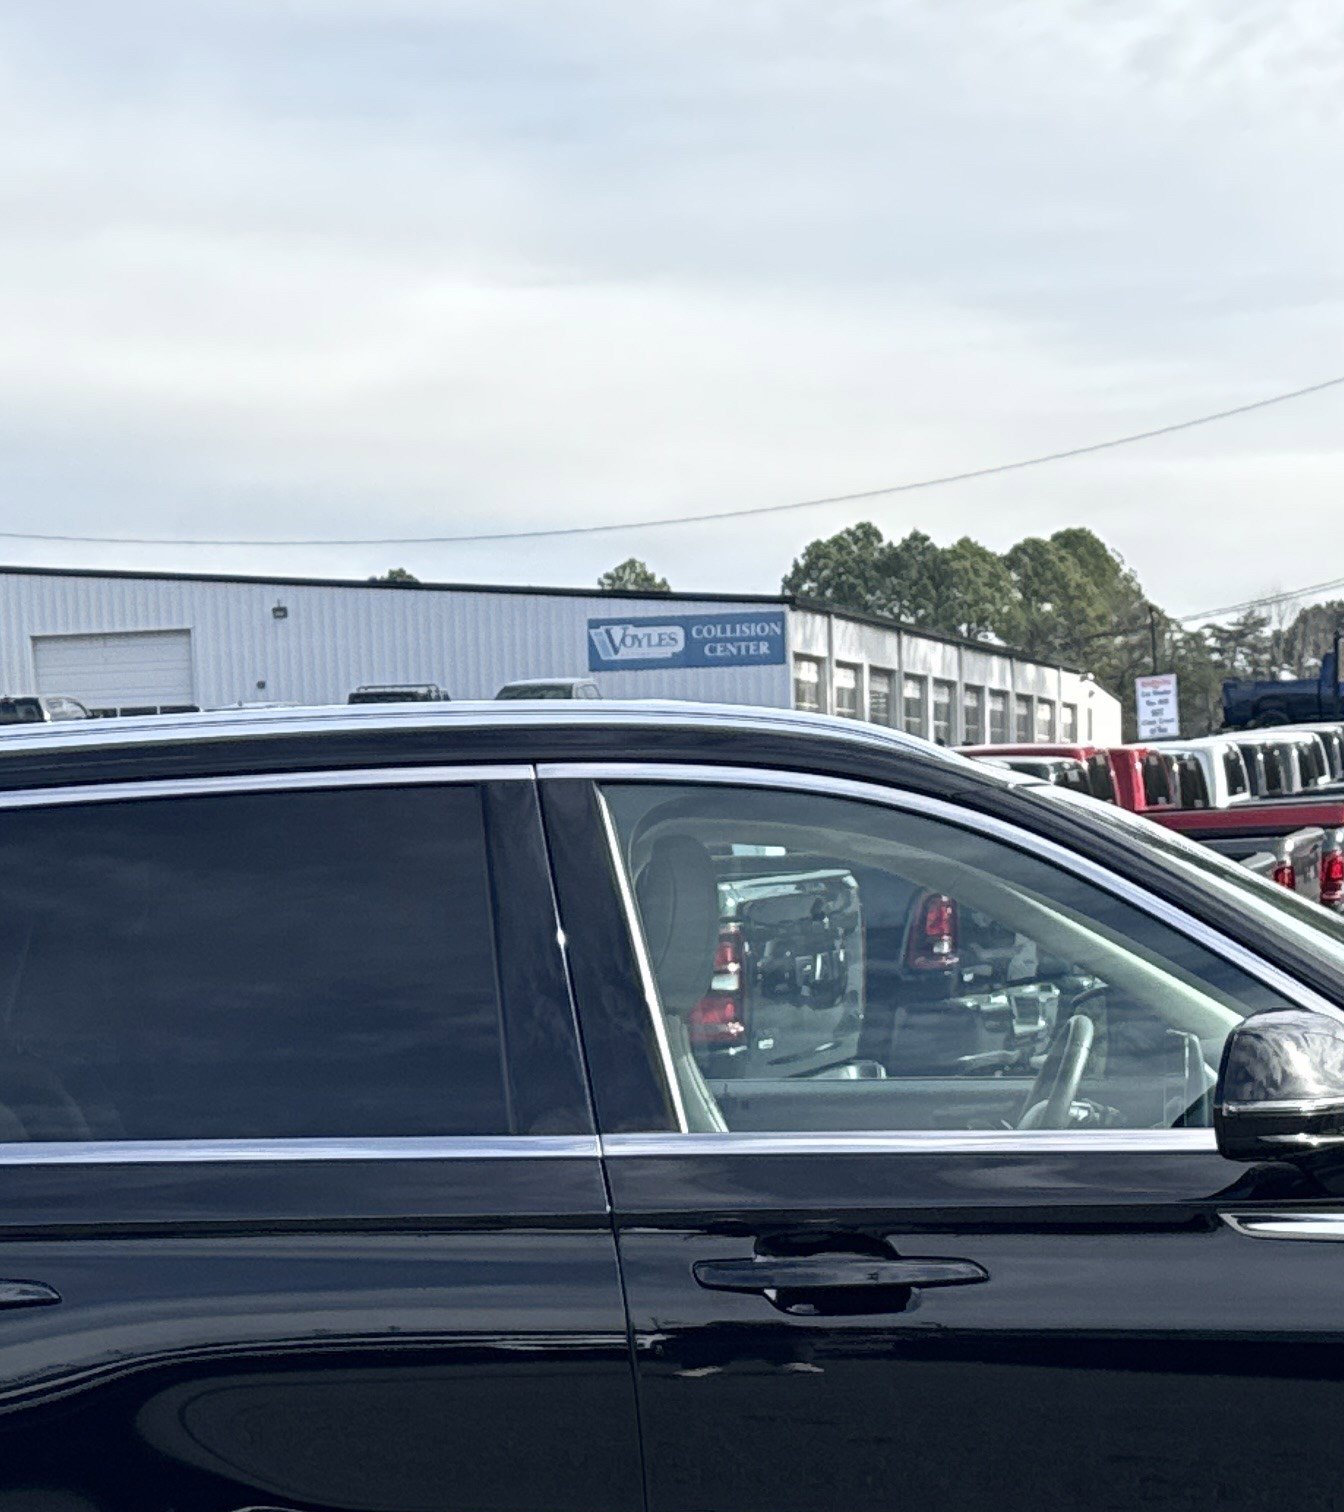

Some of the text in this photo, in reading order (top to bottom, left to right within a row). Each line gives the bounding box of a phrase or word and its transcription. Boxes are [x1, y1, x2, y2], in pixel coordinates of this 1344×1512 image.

[691, 621, 782, 639] COLLISION
[603, 625, 679, 656] VOYLES
[703, 641, 770, 656] CENTER
